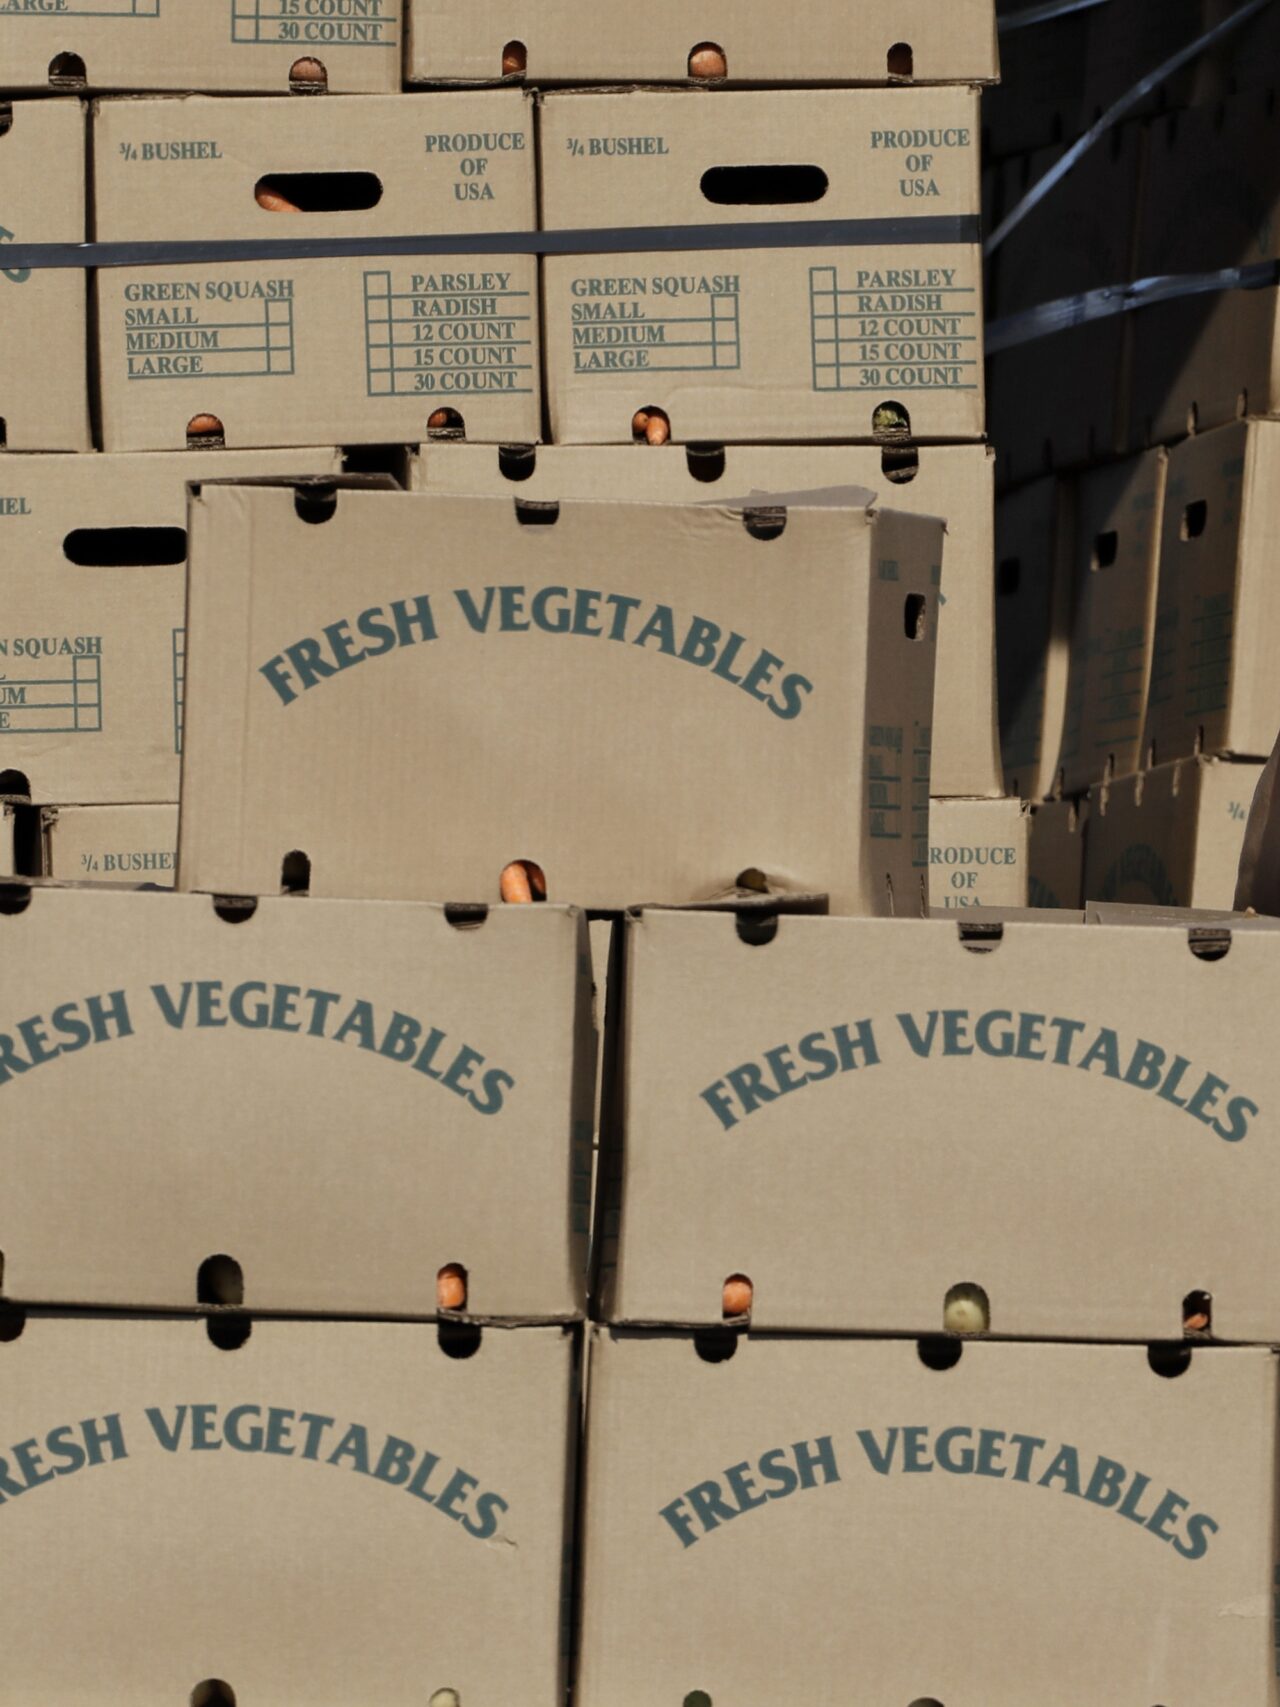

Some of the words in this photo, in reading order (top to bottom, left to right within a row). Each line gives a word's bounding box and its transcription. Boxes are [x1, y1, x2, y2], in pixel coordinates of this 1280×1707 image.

[0, 0, 68, 11] ARGE
[279, 0, 299, 15] 15
[304, 0, 382, 17] COUNT
[278, 22, 299, 40] 30
[304, 23, 383, 41] COUNT
[425, 133, 524, 153] PRODUCE
[588, 136, 669, 156] BUSHEL
[870, 128, 970, 148] PRODUCE
[141, 142, 222, 160] BUSHEL
[459, 158, 489, 177] OF
[905, 154, 933, 172] OF
[453, 182, 496, 201] USA
[899, 178, 940, 197] USA
[411, 273, 511, 293] PARSLEY
[570, 277, 647, 297] GREEN
[651, 275, 740, 296] SQUASH
[856, 269, 956, 288] PARSLEY
[124, 281, 201, 302] GREEN
[205, 279, 295, 302] SQUASH
[412, 298, 498, 318] RADISH
[571, 302, 645, 321] SMALL
[857, 294, 944, 313] RADISH
[125, 306, 200, 326] SMALL
[413, 323, 434, 341] 12
[438, 322, 516, 341] COUNT
[572, 325, 666, 345] MEDIUM
[858, 319, 879, 337] 12
[883, 318, 961, 337] COUNT
[126, 330, 220, 352] MEDIUM
[413, 348, 435, 367] 15
[438, 347, 517, 366] COUNT
[574, 350, 650, 369] LARGE
[858, 343, 880, 362] 15
[884, 342, 962, 361] COUNT
[127, 354, 204, 375] LARGE
[413, 372, 436, 392] 30
[439, 371, 518, 391] COUNT
[859, 368, 881, 387] 30
[885, 367, 963, 386] COUNT
[13, 635, 103, 659] SQUASH
[259, 594, 438, 706] FRESH
[453, 585, 814, 721] VEGETABLES
[930, 846, 1017, 865] RODUCE
[951, 871, 978, 889] OF
[0, 990, 134, 1086] RESH
[149, 979, 515, 1116] VEGETABLES
[701, 1018, 881, 1130] FRESH
[895, 1009, 1260, 1142] VEGETABLES
[0, 1413, 129, 1505] RESH
[145, 1403, 509, 1539] VEGETABLES
[658, 1436, 840, 1549] FRESH
[856, 1425, 1219, 1560] VEGETABLES
